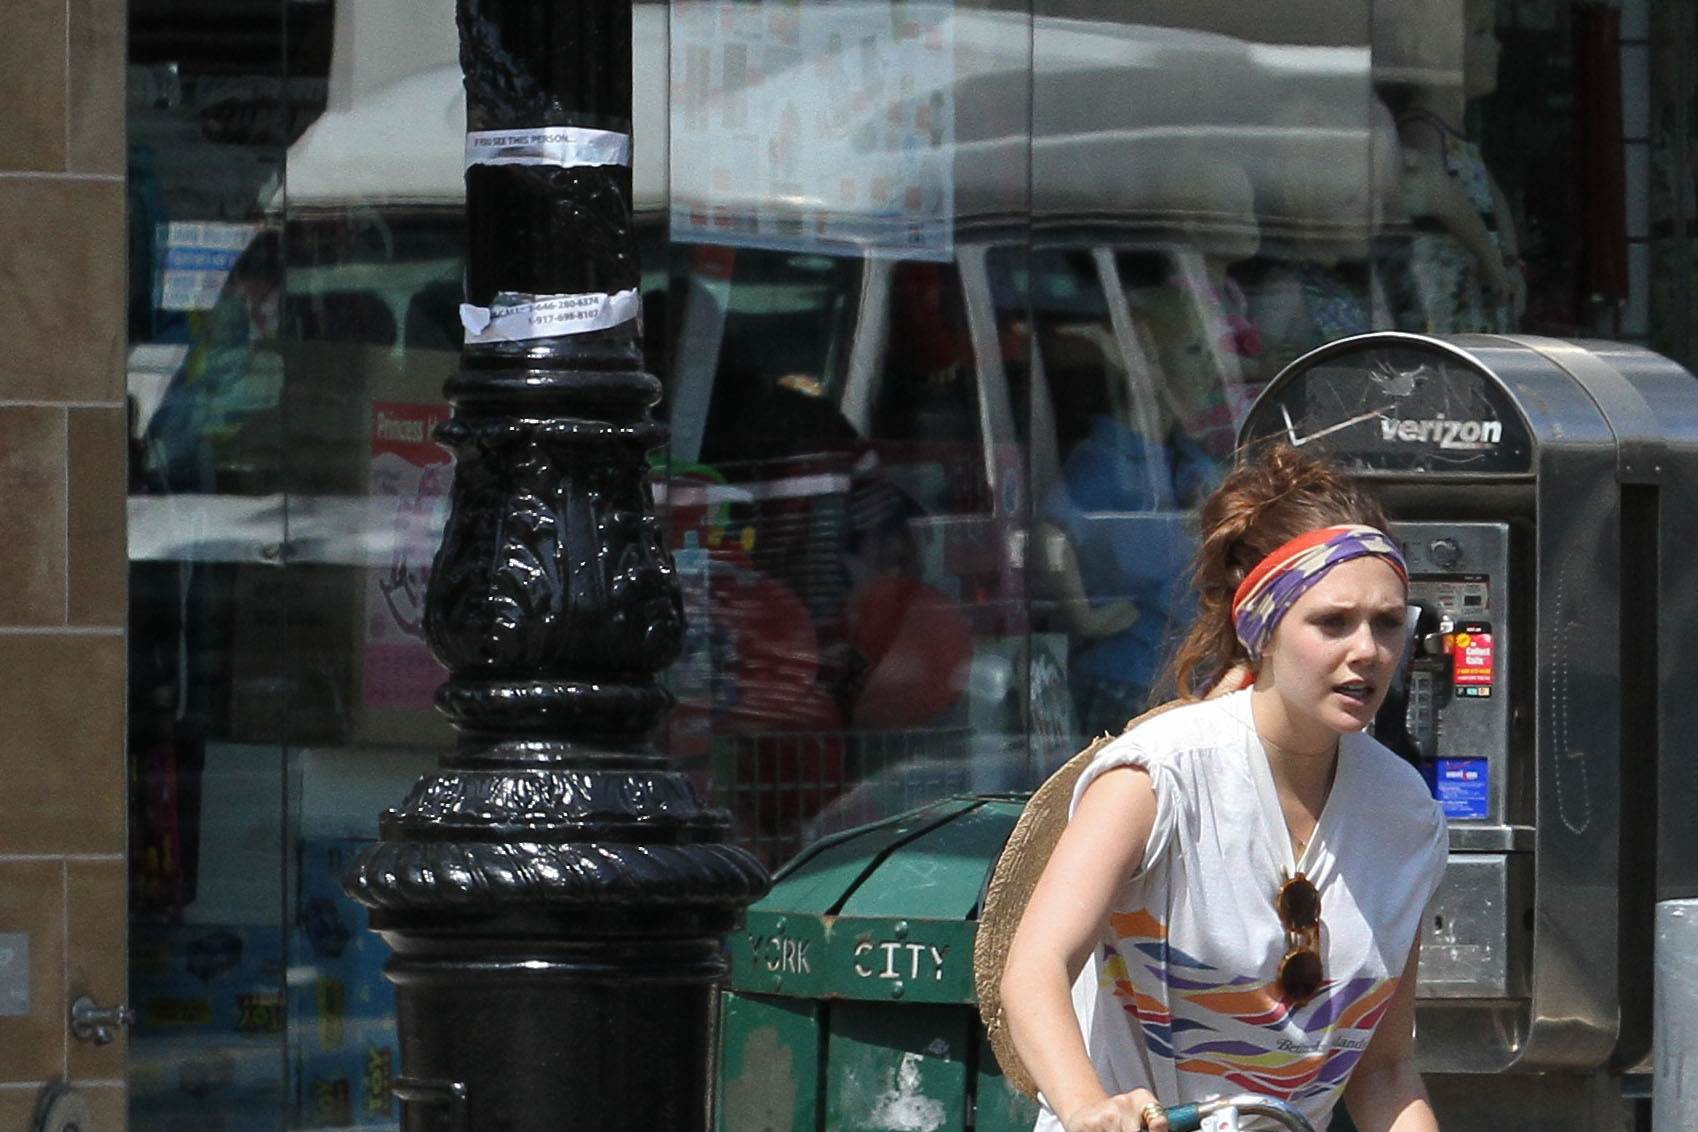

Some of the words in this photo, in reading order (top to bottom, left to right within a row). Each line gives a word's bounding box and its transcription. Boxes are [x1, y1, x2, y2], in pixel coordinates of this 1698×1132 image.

[508, 135, 529, 145] THIS
[1380, 412, 1502, 449] verizon
[749, 936, 811, 975] YORK
[853, 941, 950, 981] CITY
